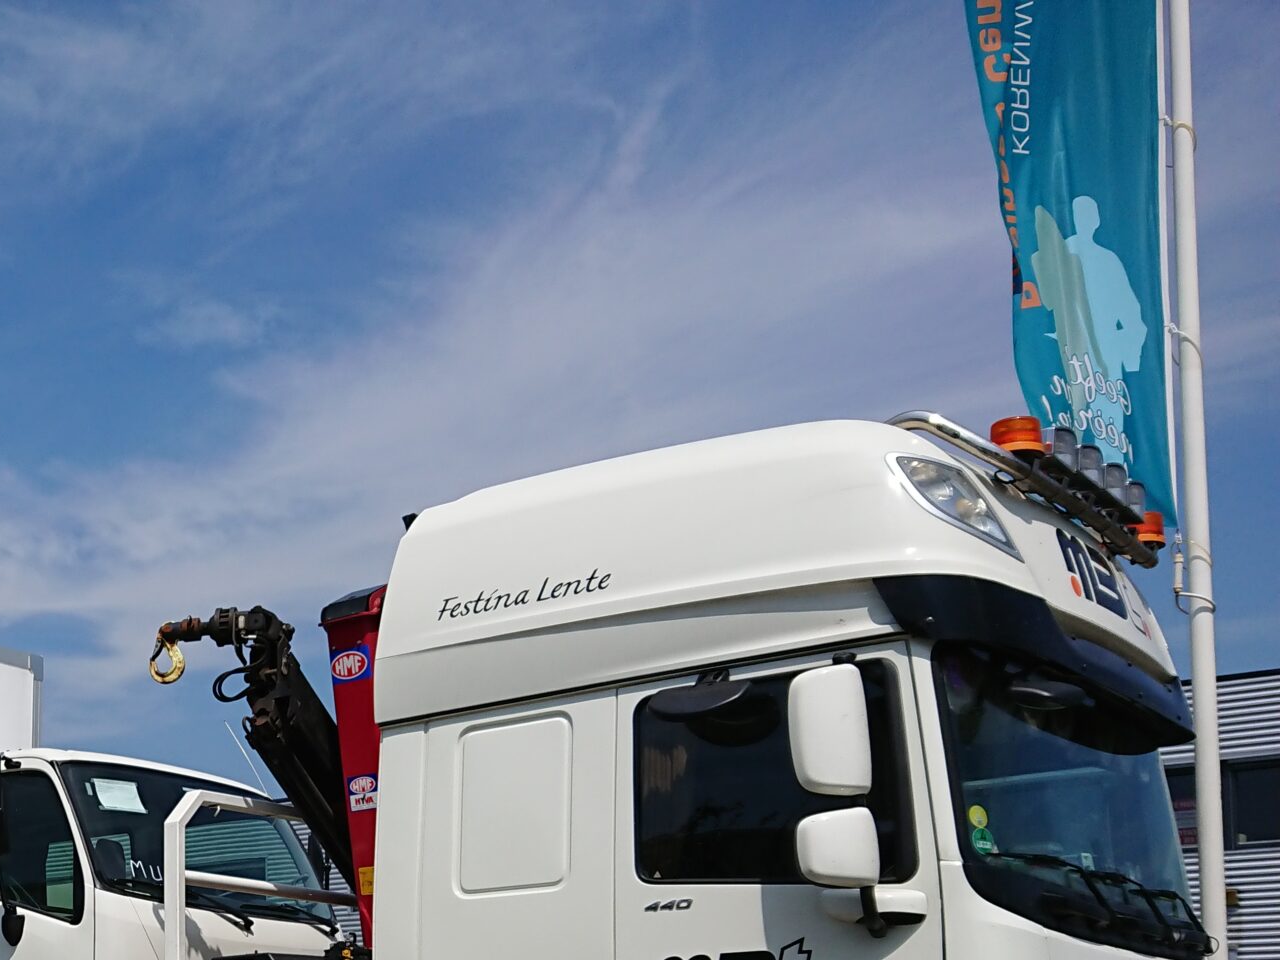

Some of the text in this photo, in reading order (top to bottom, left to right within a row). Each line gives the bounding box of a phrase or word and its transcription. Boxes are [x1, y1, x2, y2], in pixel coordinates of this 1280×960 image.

[437, 567, 613, 622] Festina Lente
[334, 654, 363, 676] HMF
[351, 778, 374, 793] HMF
[354, 793, 375, 806] HYVA
[644, 898, 694, 913] 440
